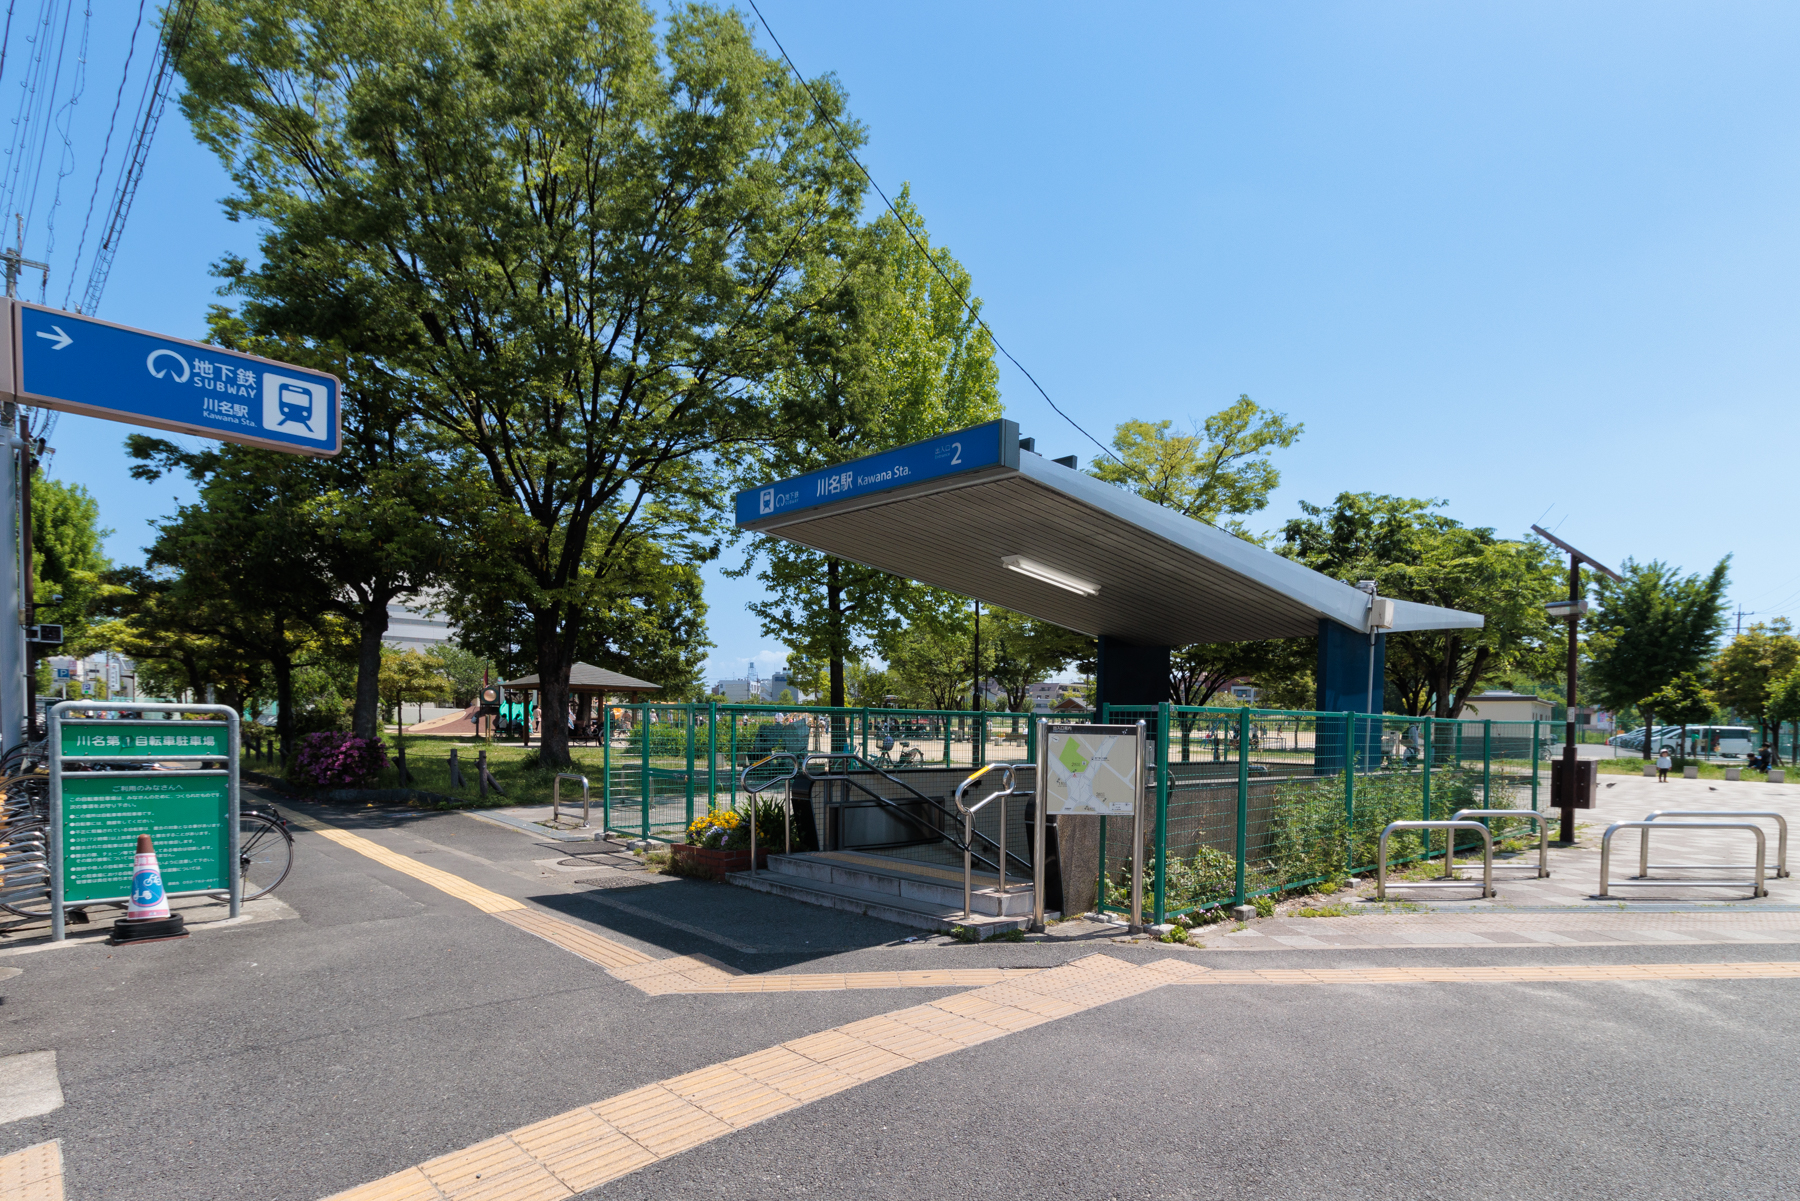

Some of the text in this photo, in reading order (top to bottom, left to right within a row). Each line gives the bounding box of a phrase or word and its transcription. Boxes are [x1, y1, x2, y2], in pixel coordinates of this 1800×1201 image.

[193, 357, 257, 388] 地下鉄
[194, 376, 257, 399] SUBWAY
[203, 397, 249, 418] 川名駅
[203, 411, 258, 428] Kawana Sta.
[950, 442, 962, 466] 2
[816, 465, 912, 498] 川名駅 Kawana Sta.
[76, 735, 215, 747] 川名第1自転車駐車場
